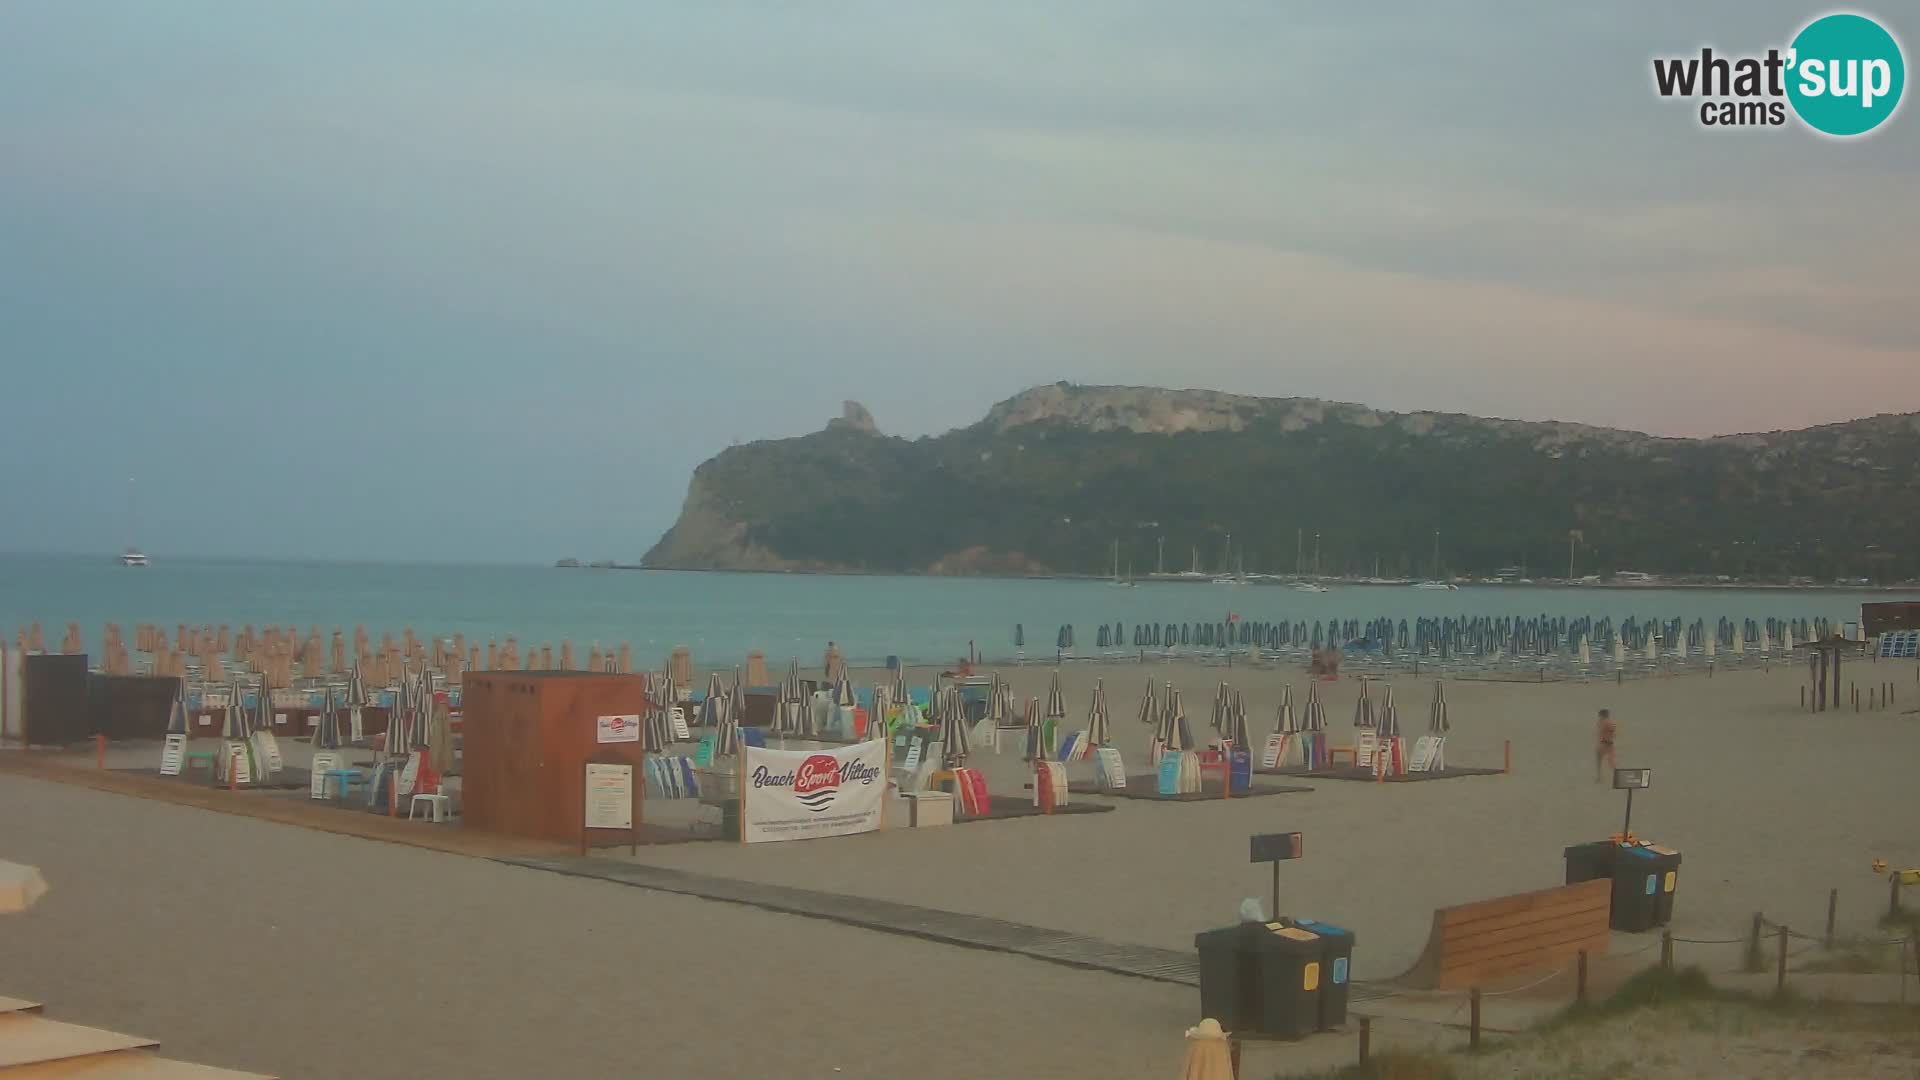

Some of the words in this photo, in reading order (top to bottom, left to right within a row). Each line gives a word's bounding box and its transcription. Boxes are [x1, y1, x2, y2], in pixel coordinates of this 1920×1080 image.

[752, 765, 795, 788] Beach
[798, 764, 839, 789] Sport
[838, 757, 880, 785] Village
